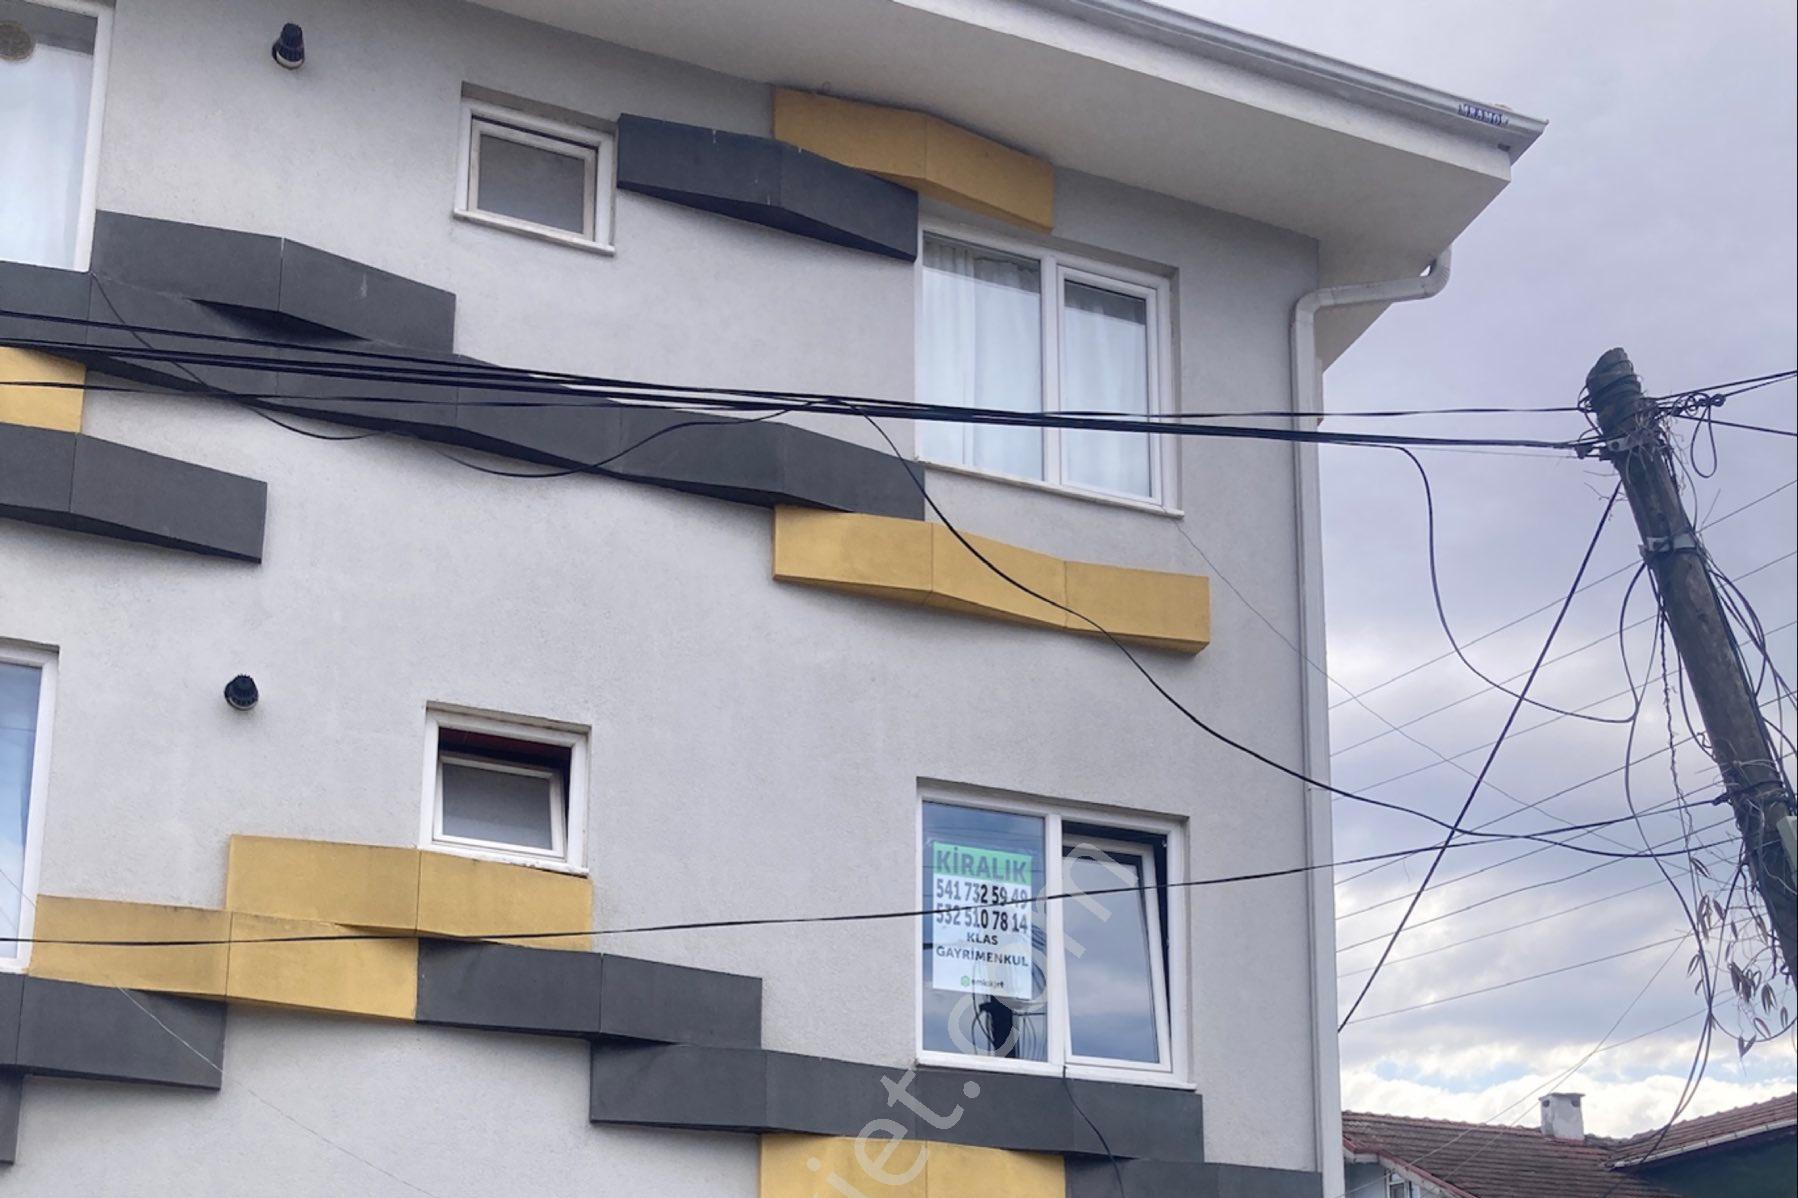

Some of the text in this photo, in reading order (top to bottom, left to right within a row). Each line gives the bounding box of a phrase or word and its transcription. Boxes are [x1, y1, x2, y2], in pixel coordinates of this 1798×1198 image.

[937, 847, 1027, 883] KİRALIK
[936, 878, 1028, 909] 541 732 59 49
[936, 903, 1028, 935] 532 510 78 14
[967, 931, 999, 946] KLAS
[936, 945, 1029, 967] GAYRİMENKUL
